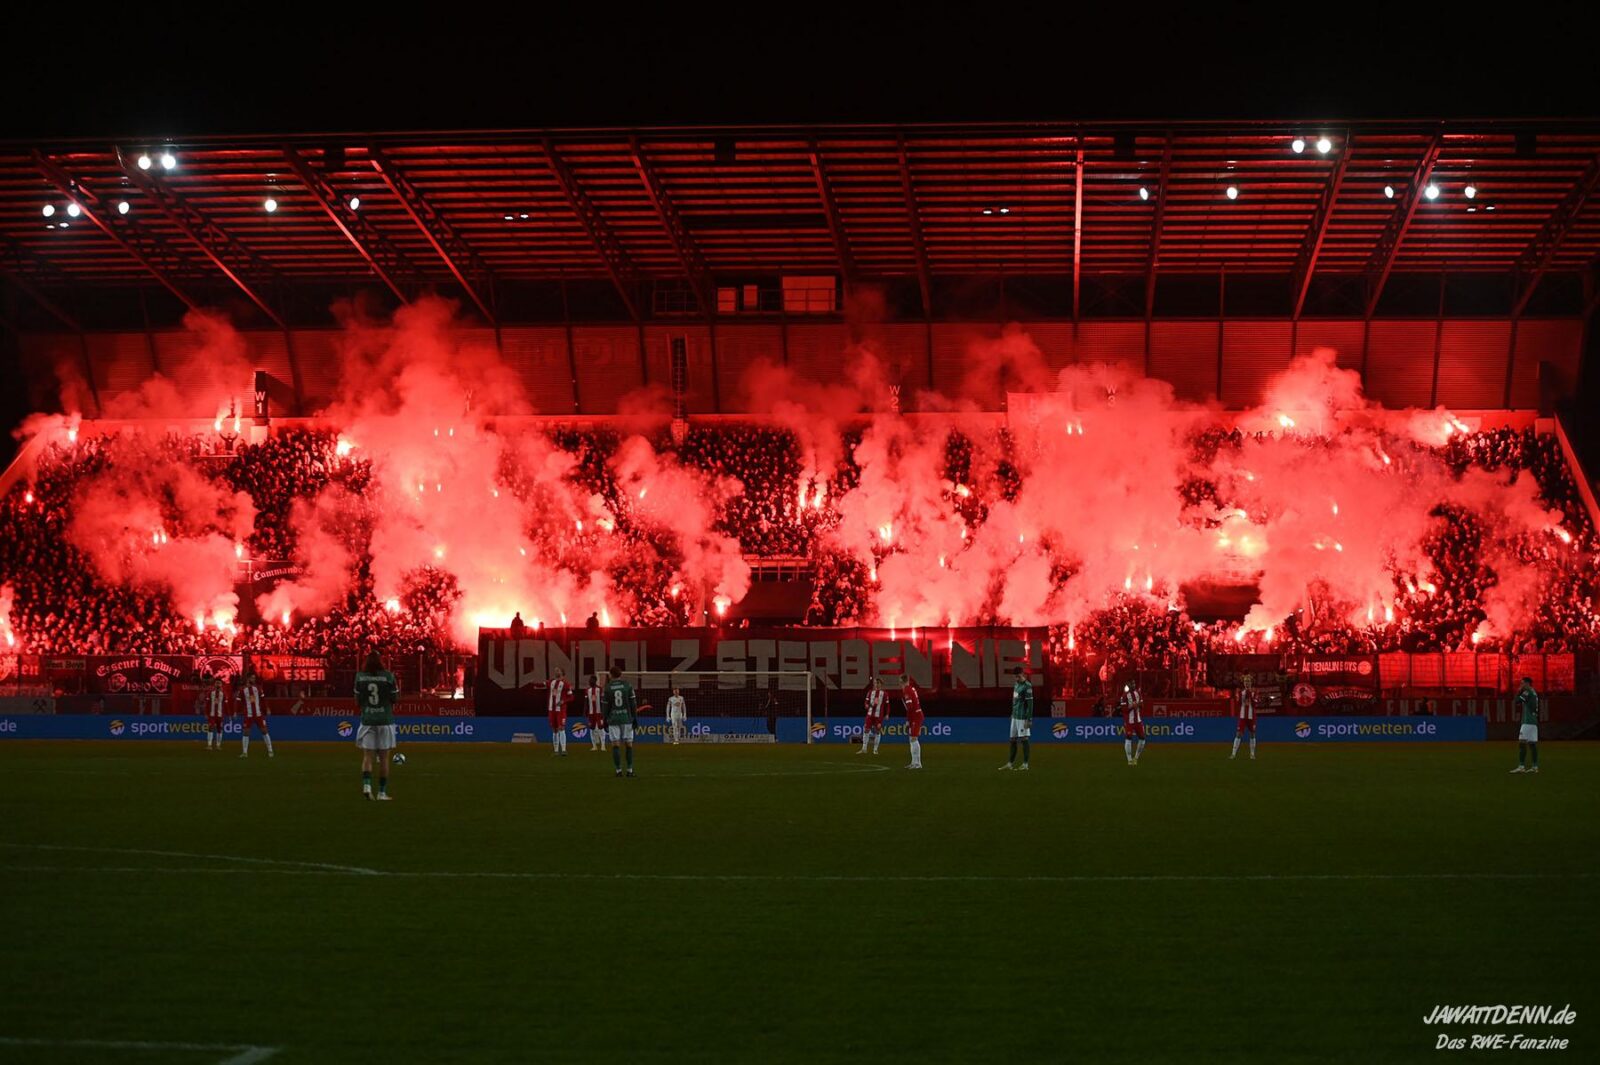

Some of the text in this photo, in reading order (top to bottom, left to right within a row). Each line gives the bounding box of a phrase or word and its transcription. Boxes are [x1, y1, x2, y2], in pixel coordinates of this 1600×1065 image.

[717, 639, 933, 690] STERBEN
[951, 638, 1043, 688] NIE!
[283, 669, 325, 681] ESSEN
[367, 683, 379, 705] 3
[614, 690, 623, 707] 8
[1451, 700, 1548, 722] CHANCN
[130, 721, 242, 736] sportwettede
[1075, 722, 1194, 739] sportwten.de
[1318, 721, 1436, 738] sportwetten.de
